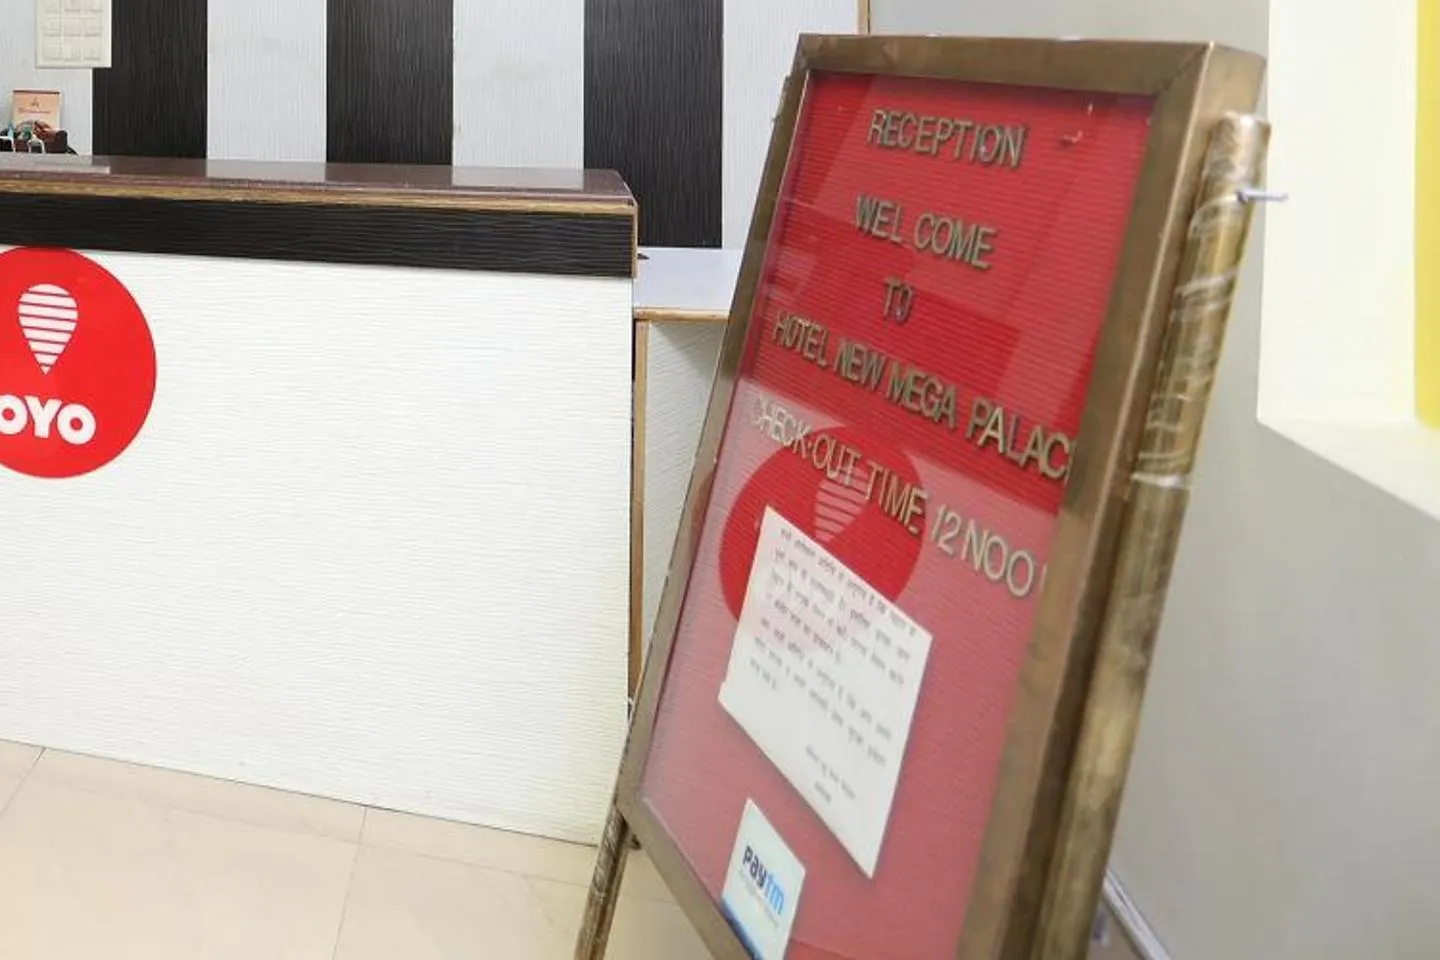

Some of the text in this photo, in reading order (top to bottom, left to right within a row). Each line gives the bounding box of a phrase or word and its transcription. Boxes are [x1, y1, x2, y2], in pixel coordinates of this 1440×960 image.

[867, 108, 1027, 169] RECEPTION
[882, 276, 915, 325] TO
[772, 310, 1076, 488] HOTEL NEW MEGA PALAC
[866, 460, 929, 536] TIME
[931, 503, 961, 557] 12
[961, 518, 1048, 597] NOO
